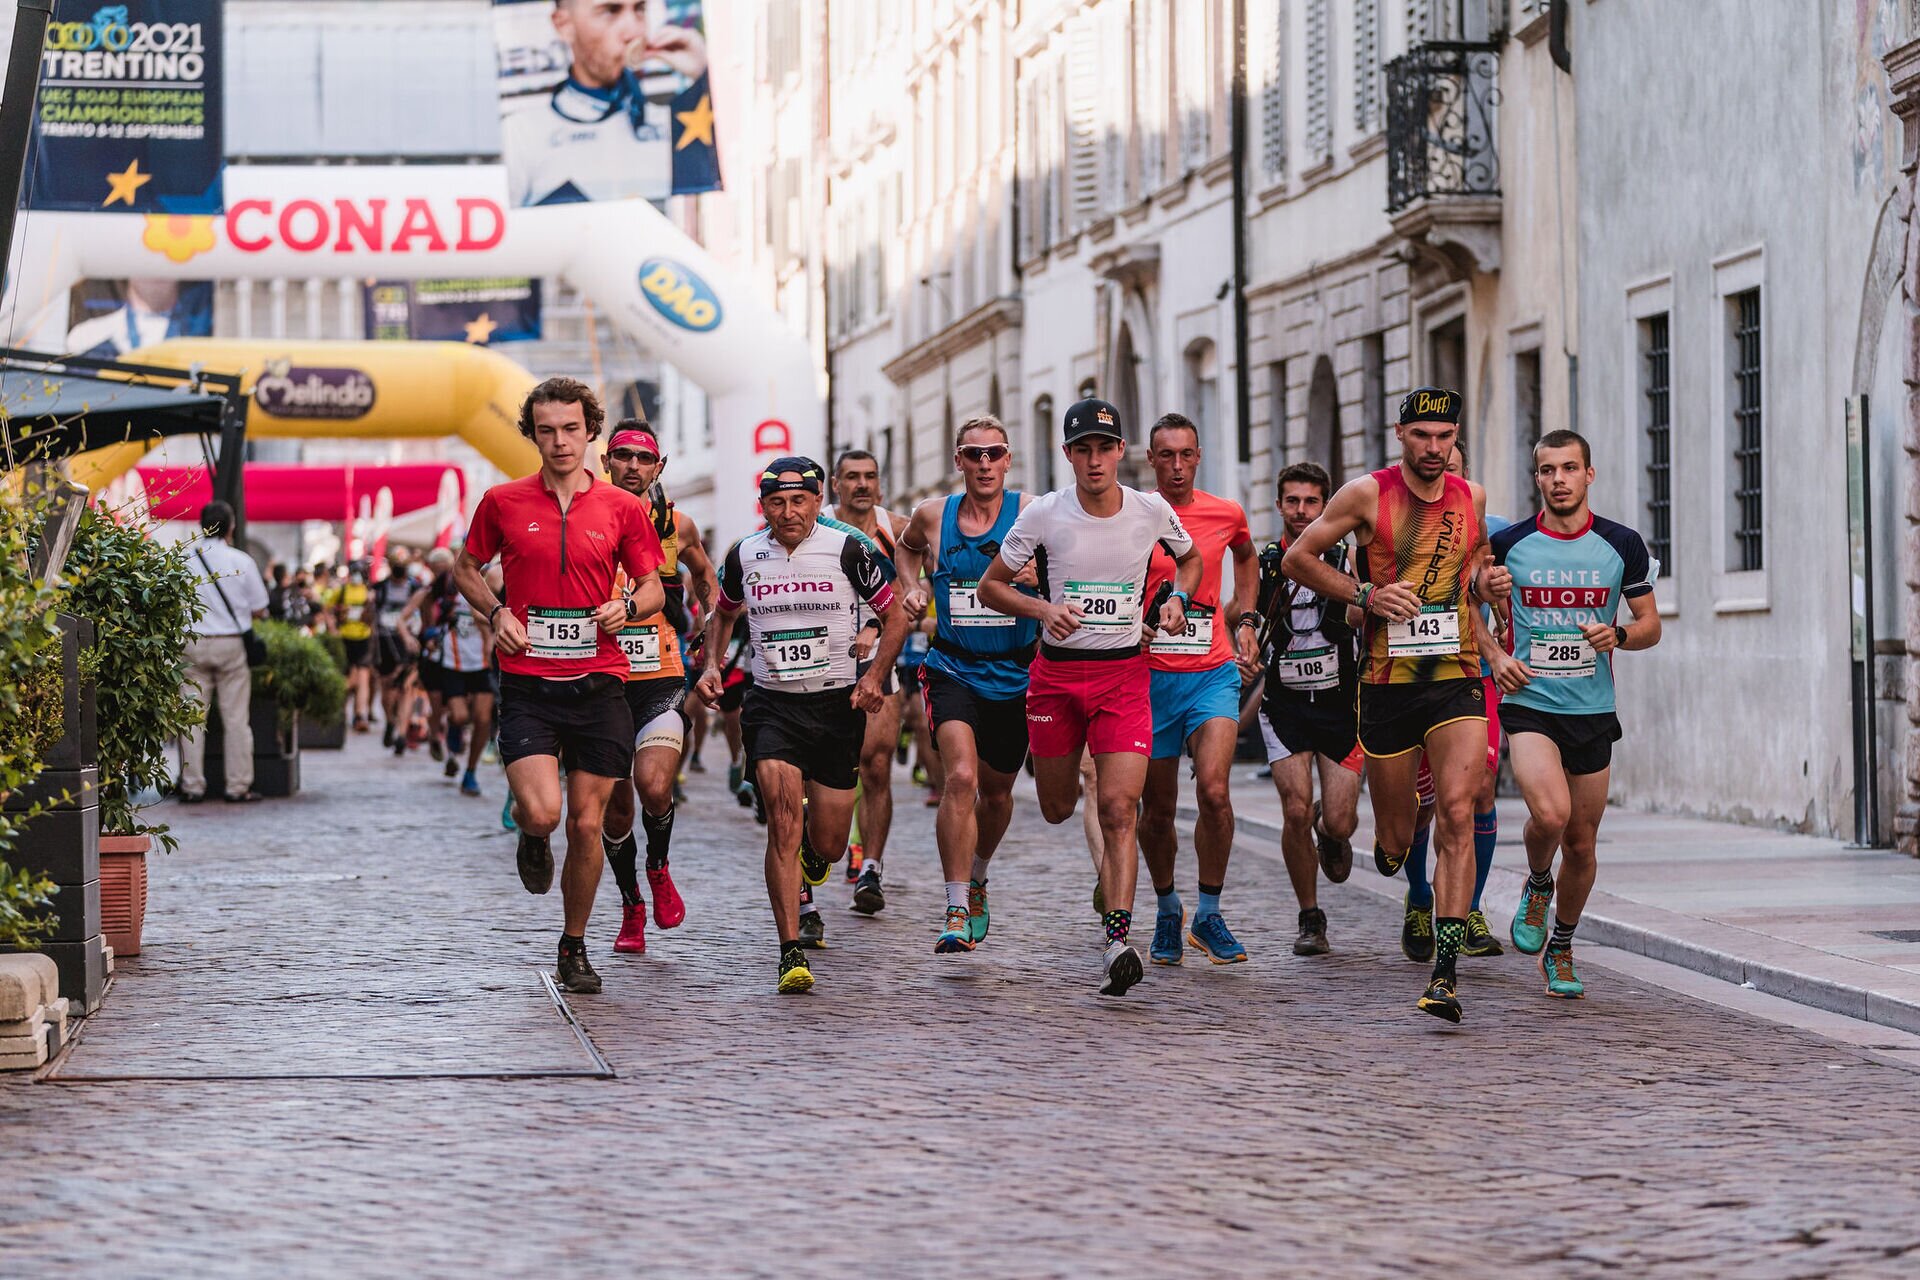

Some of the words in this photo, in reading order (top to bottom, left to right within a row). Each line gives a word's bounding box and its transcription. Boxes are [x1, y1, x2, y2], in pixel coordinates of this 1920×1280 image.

[130, 22, 205, 53] 2021
[43, 50, 204, 80] TRENTINO
[75, 89, 119, 105] ROAD
[121, 89, 205, 106] EUROPEAN
[40, 103, 205, 125] CHAMPIONSHIPS
[226, 199, 505, 252] CONAD
[642, 266, 716, 326] DAO
[1451, 513, 1464, 554] TEAM
[1416, 510, 1455, 603] PORTIVA
[1530, 569, 1600, 585] GENTE
[1083, 598, 1117, 615] 280
[1525, 590, 1606, 606] FUORI
[1407, 618, 1441, 637] 143
[1532, 610, 1598, 627] STRADA
[547, 623, 580, 641] 153
[778, 644, 812, 663] 139
[1548, 645, 1581, 661] 285
[1294, 661, 1324, 677] 108
